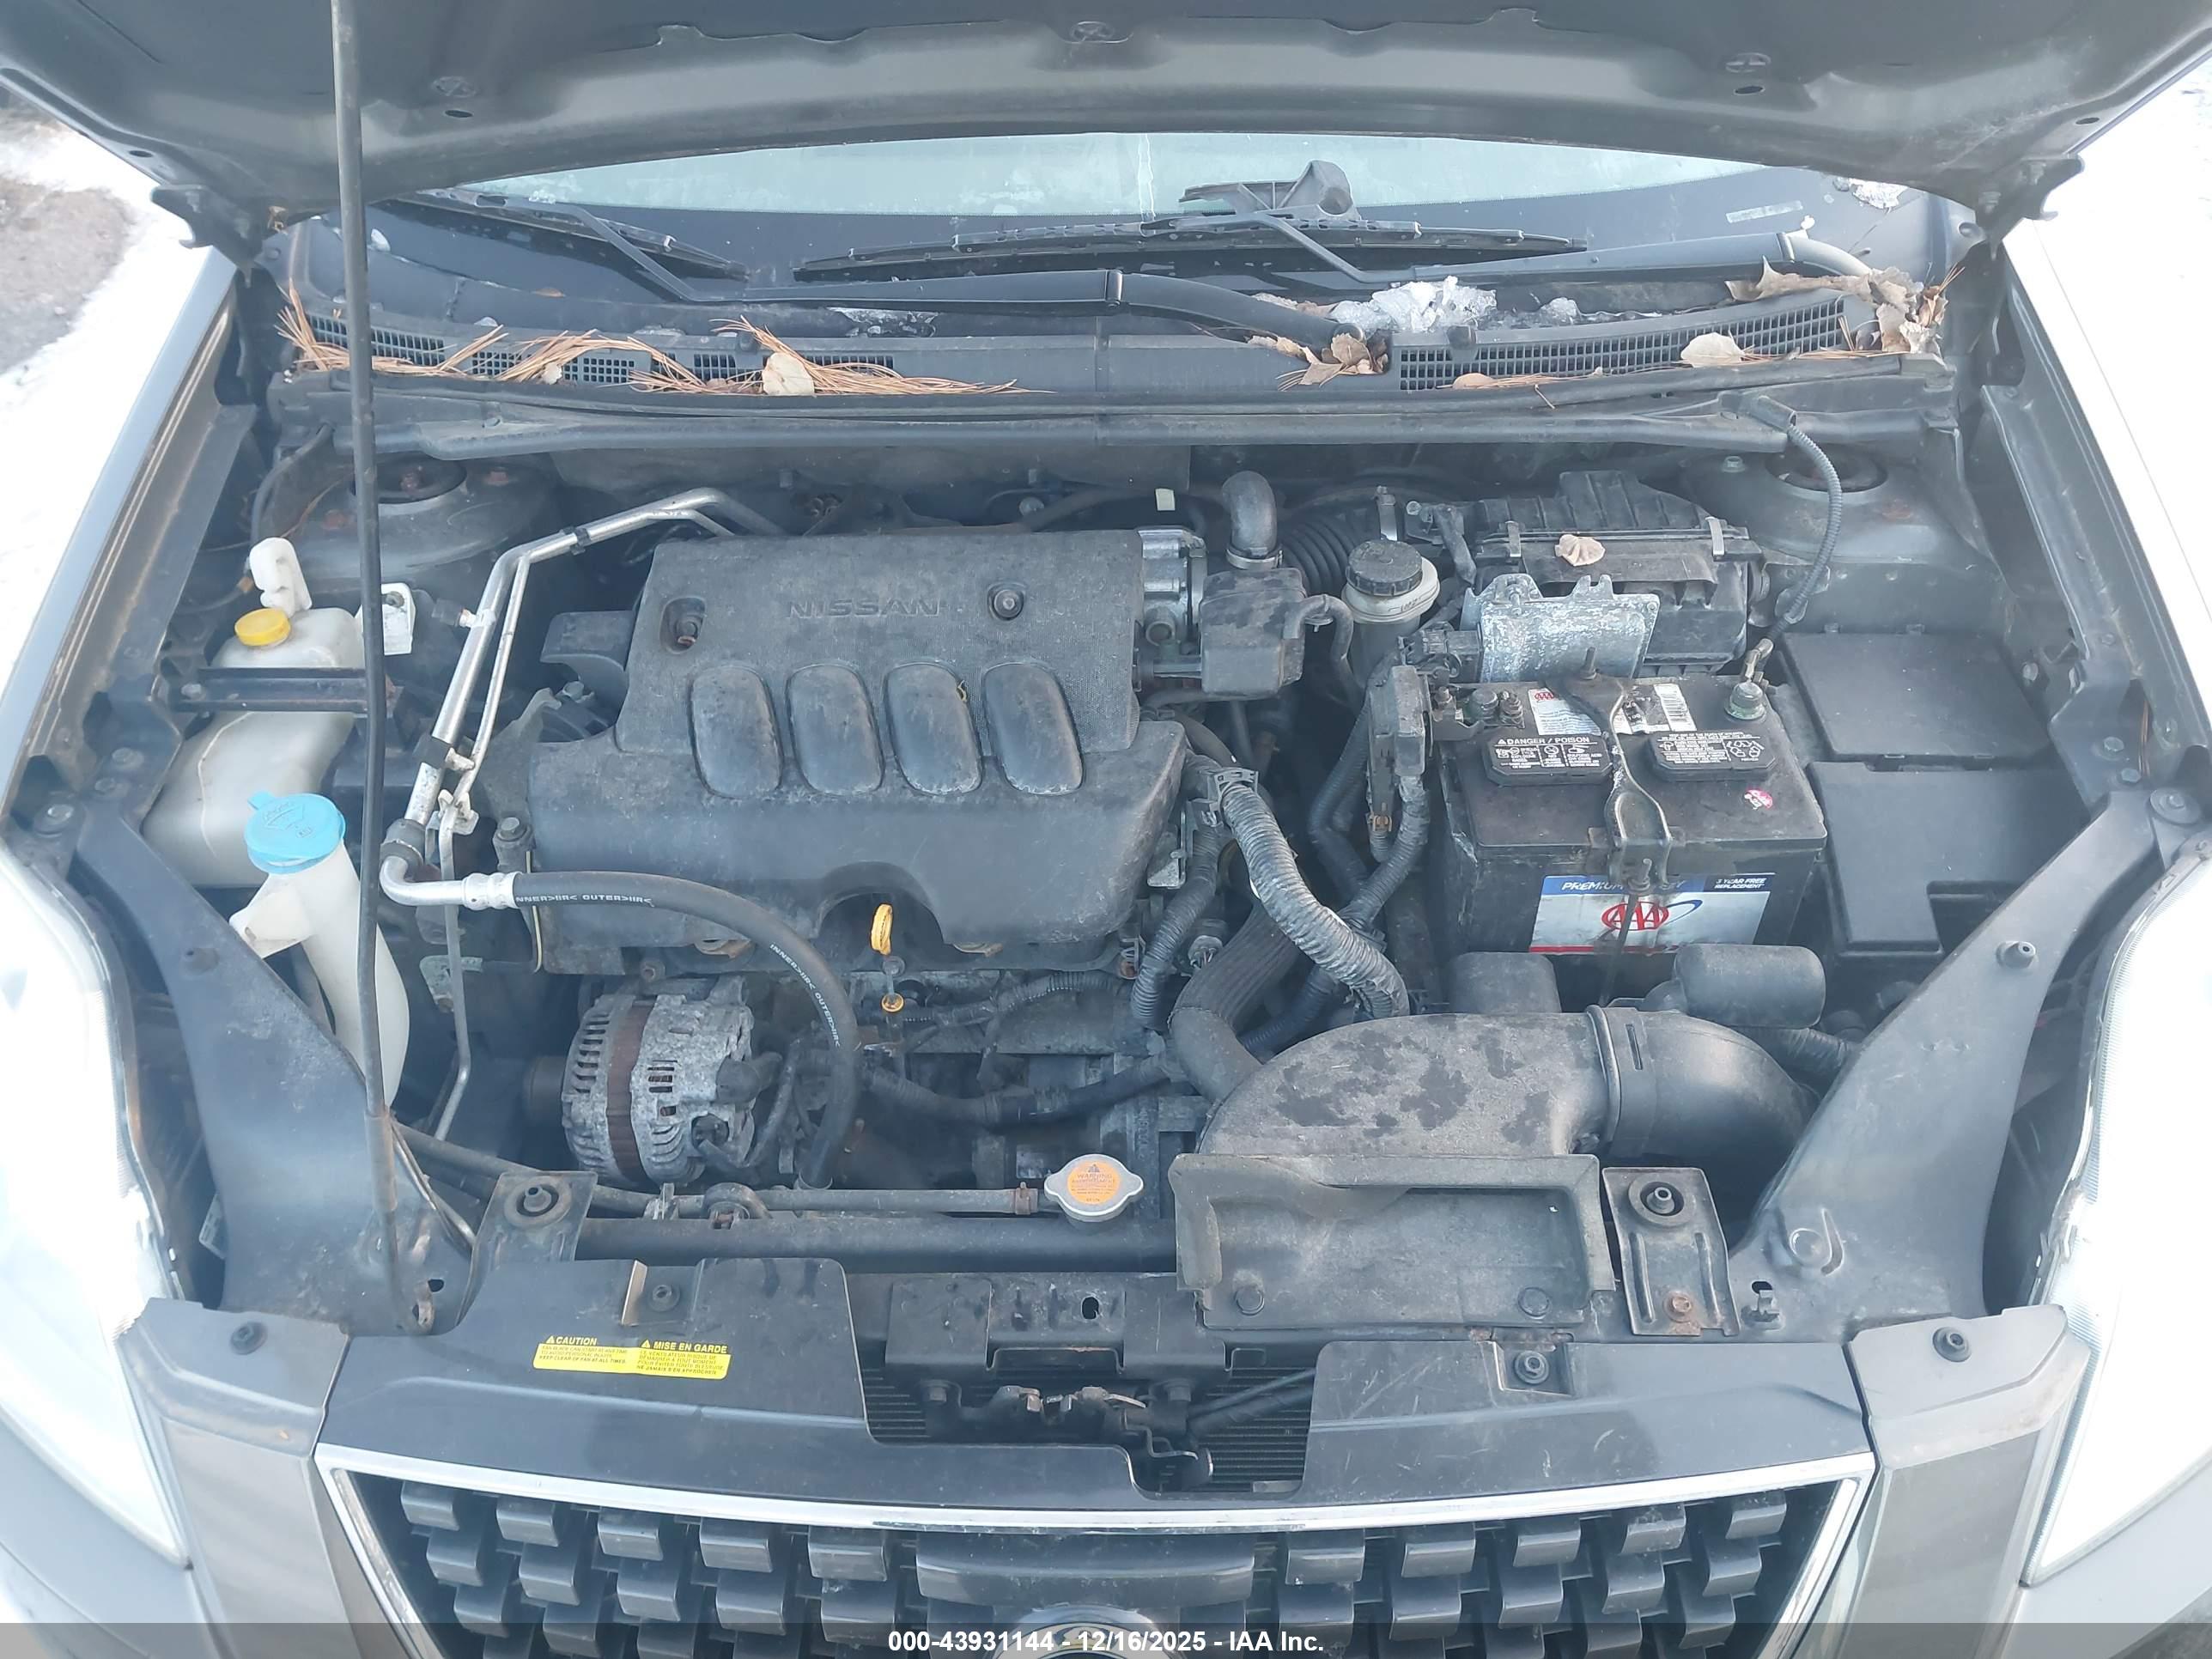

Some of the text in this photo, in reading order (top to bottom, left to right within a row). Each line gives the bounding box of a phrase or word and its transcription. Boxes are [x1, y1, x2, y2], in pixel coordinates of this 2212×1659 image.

[789, 599, 940, 618] NISSAN
[1561, 881, 1625, 890] PREMIUM
[1608, 902, 1663, 930] AAA
[556, 1336, 598, 1346] CAUTION
[653, 1341, 727, 1353] MISE EN GARDE
